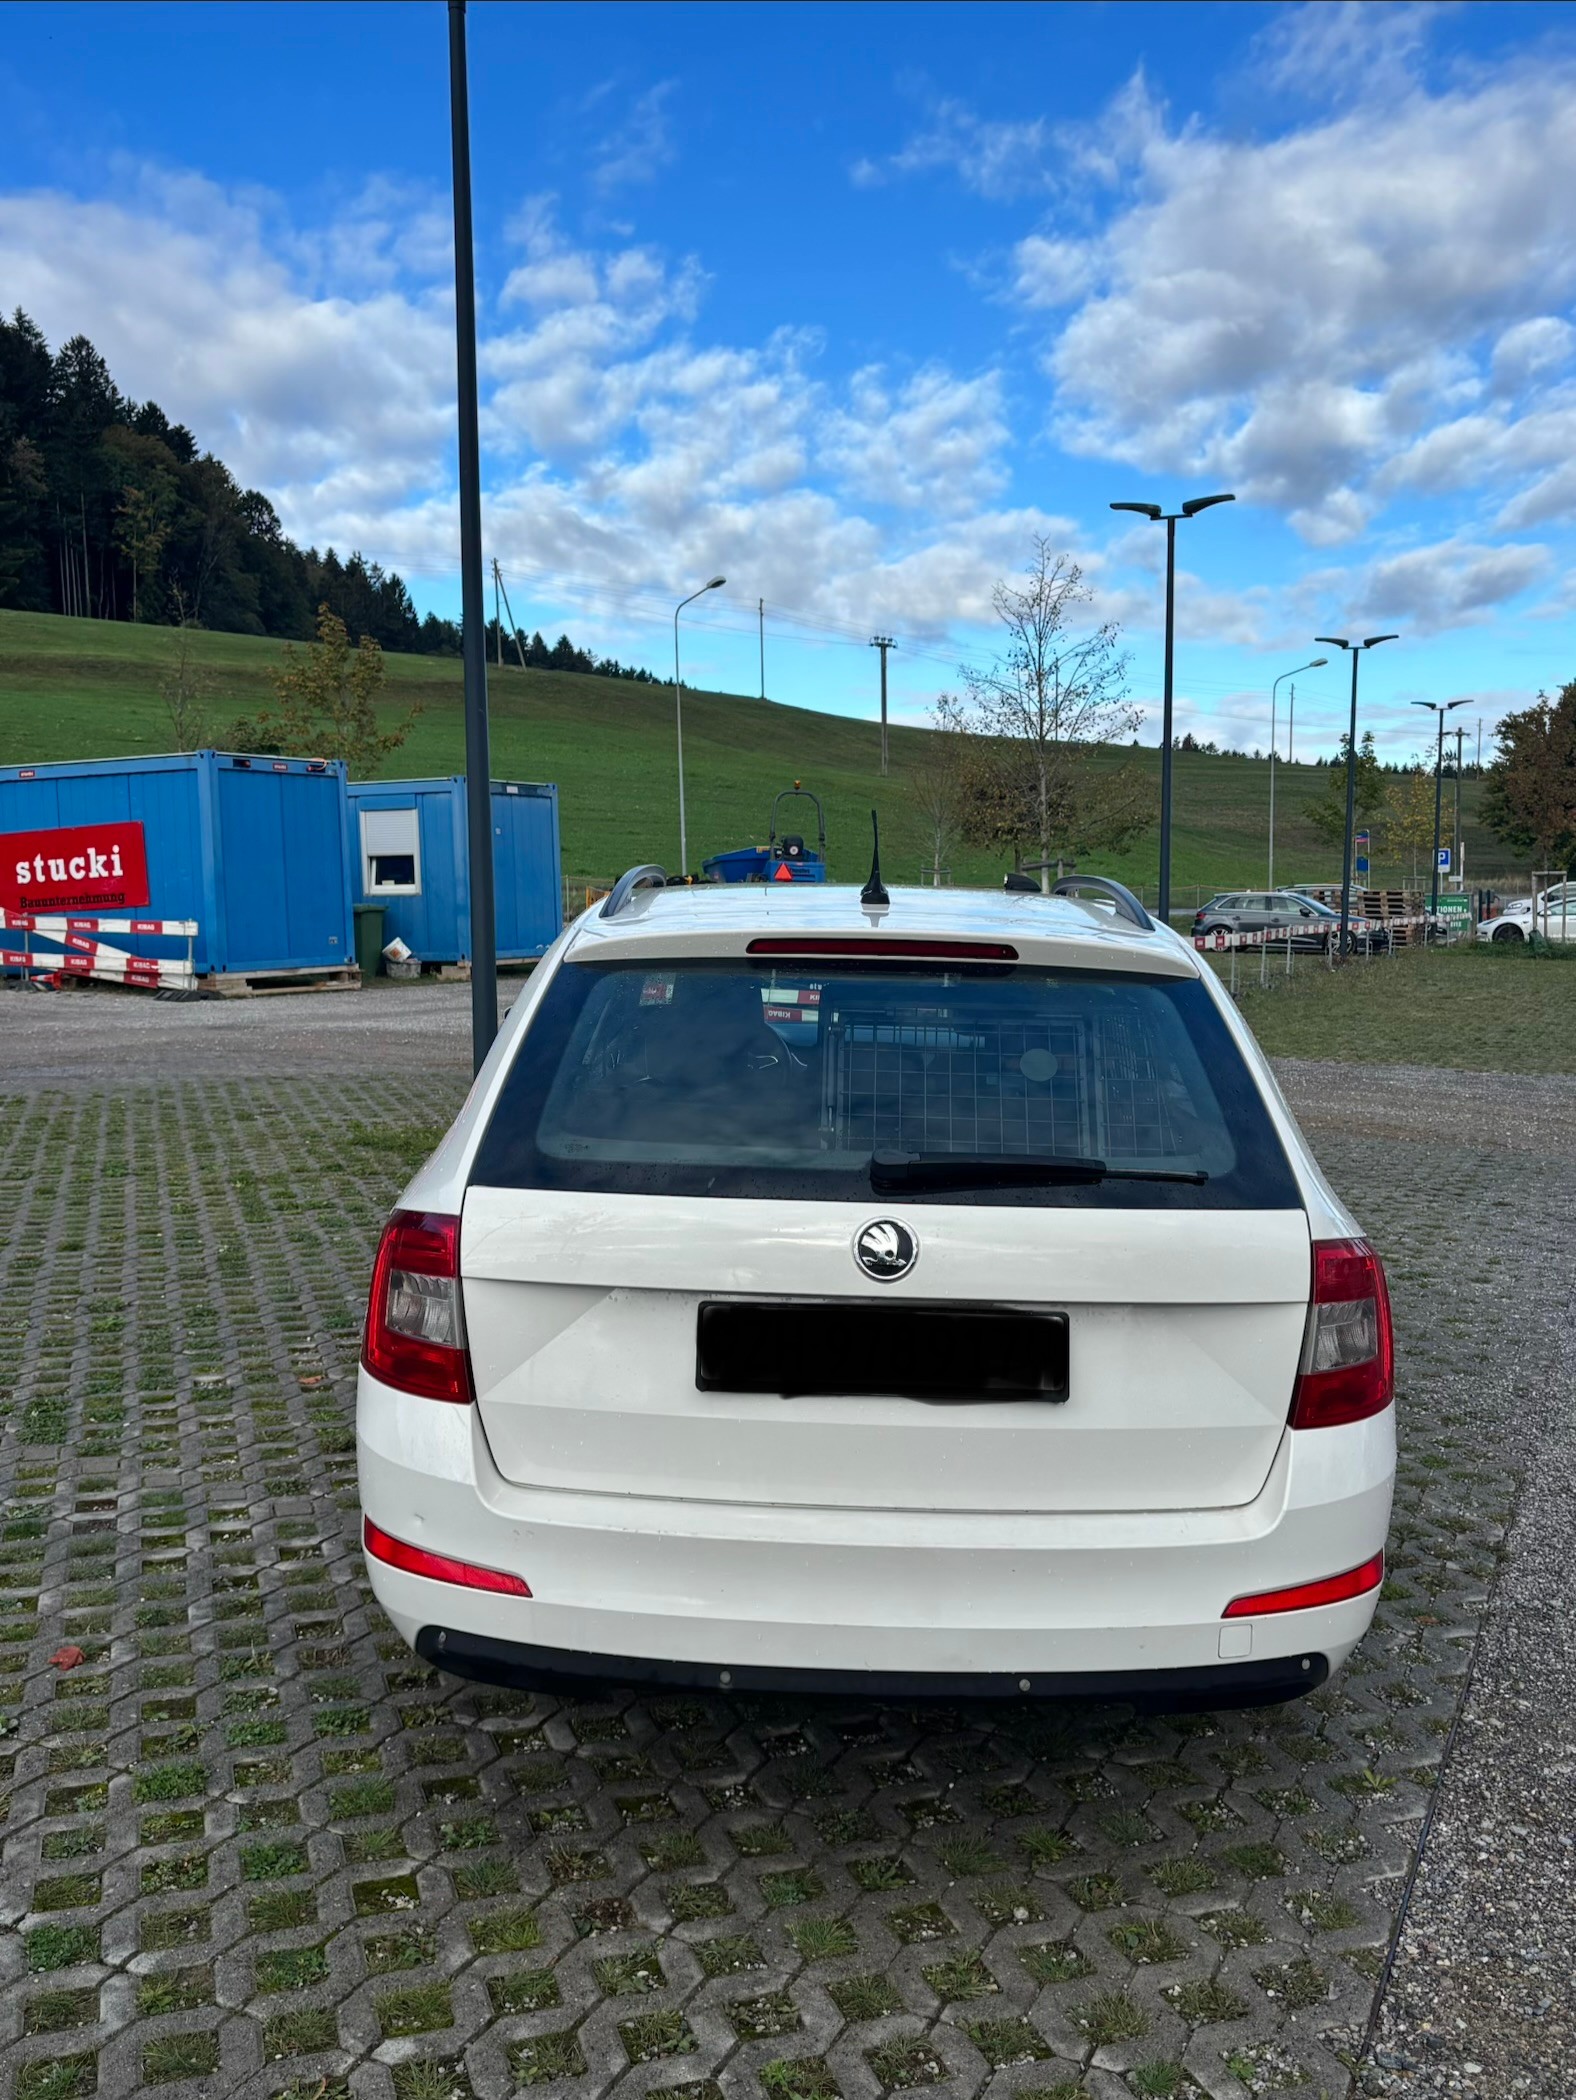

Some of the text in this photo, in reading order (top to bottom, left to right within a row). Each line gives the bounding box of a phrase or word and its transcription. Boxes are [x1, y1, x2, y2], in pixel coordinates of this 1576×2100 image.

[15, 844, 124, 885] stucki
[1438, 851, 1446, 865] P
[20, 893, 125, 908] Bauunternehmung
[137, 923, 155, 931] KIBAG
